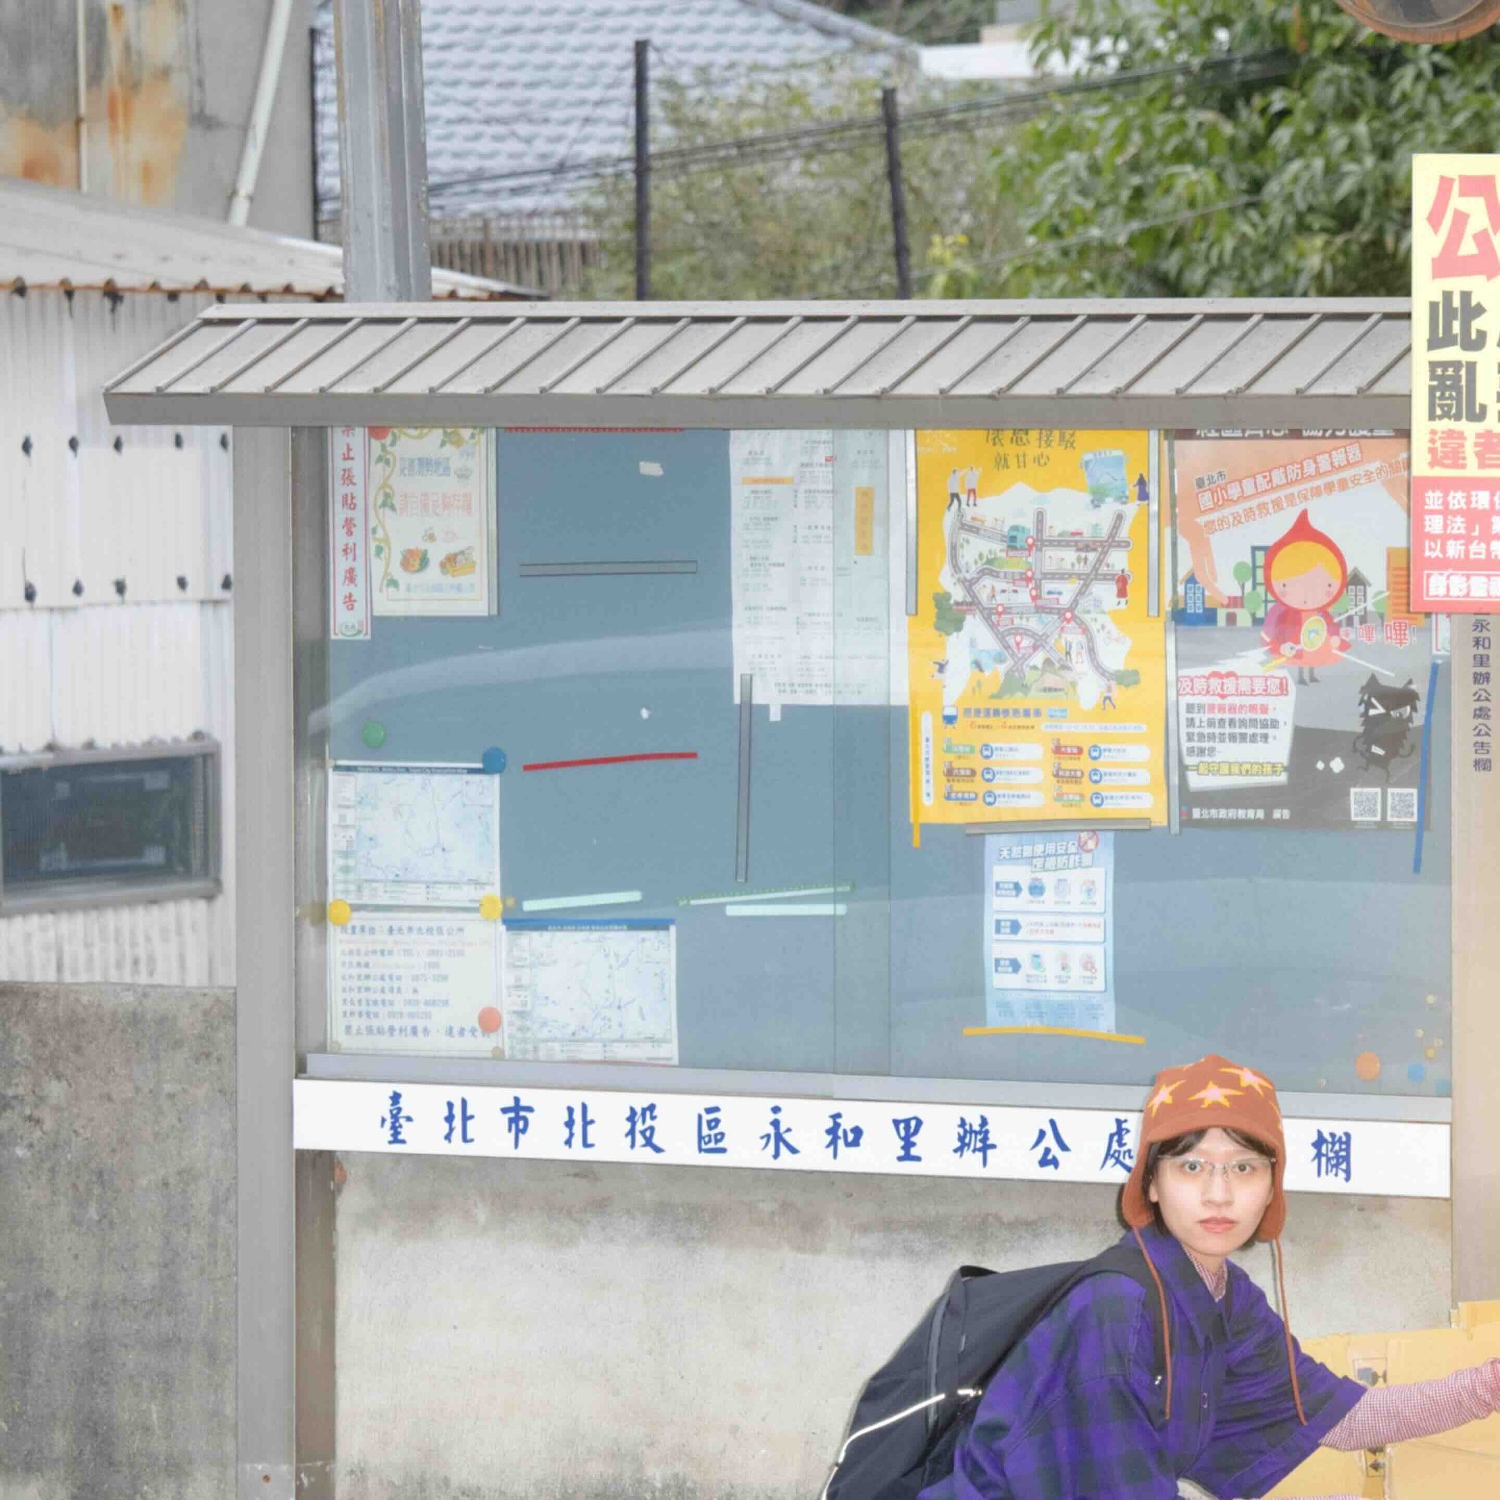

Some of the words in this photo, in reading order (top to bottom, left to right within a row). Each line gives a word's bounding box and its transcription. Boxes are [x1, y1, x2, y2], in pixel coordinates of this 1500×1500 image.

[1472, 613, 1492, 772] 永和里辦公處公告欄
